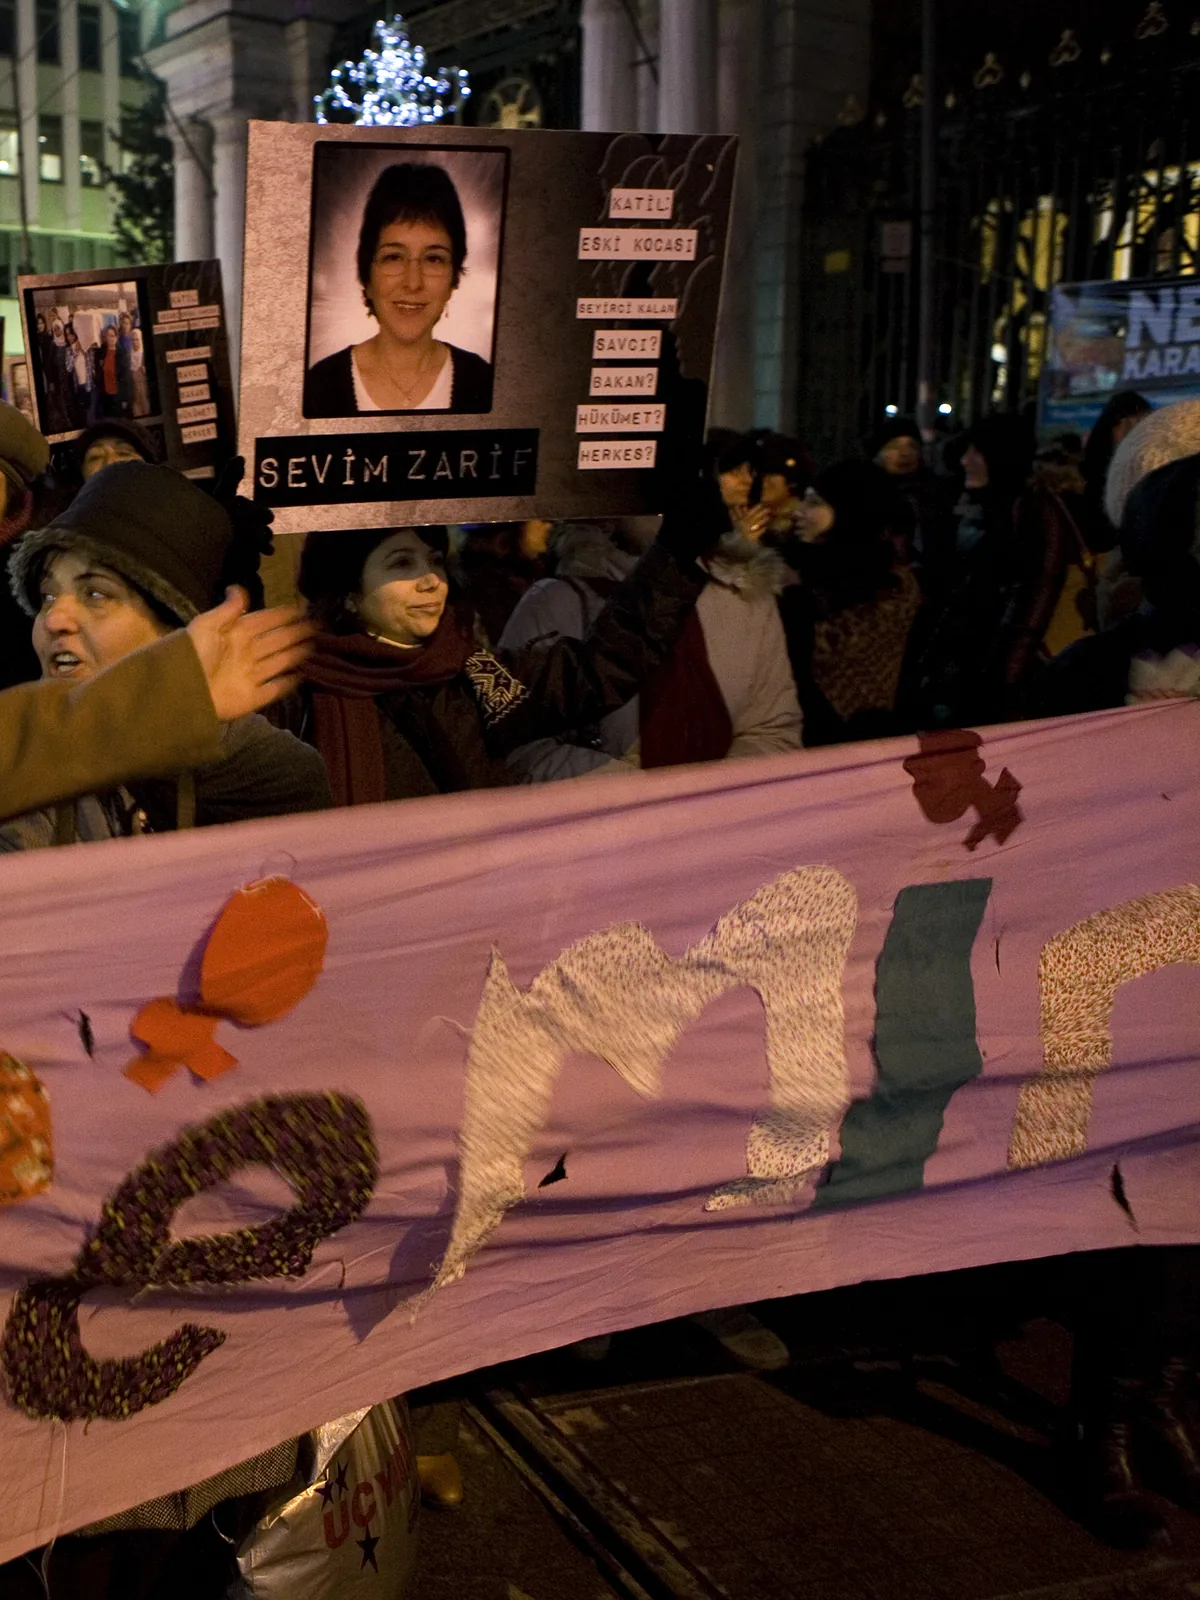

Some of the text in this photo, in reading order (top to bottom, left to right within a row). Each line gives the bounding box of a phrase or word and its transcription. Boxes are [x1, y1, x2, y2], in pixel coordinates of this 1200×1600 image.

[581, 236, 693, 253] ESKİ KOCASI
[579, 302, 675, 314] SEYİRCİ KALAN
[596, 336, 658, 351] SAVCI?
[593, 373, 654, 389] BAKAN?
[578, 408, 662, 425] HÜKÜMET?
[580, 446, 654, 462] HERKES?
[259, 443, 533, 488] SEVİM ZARİF
